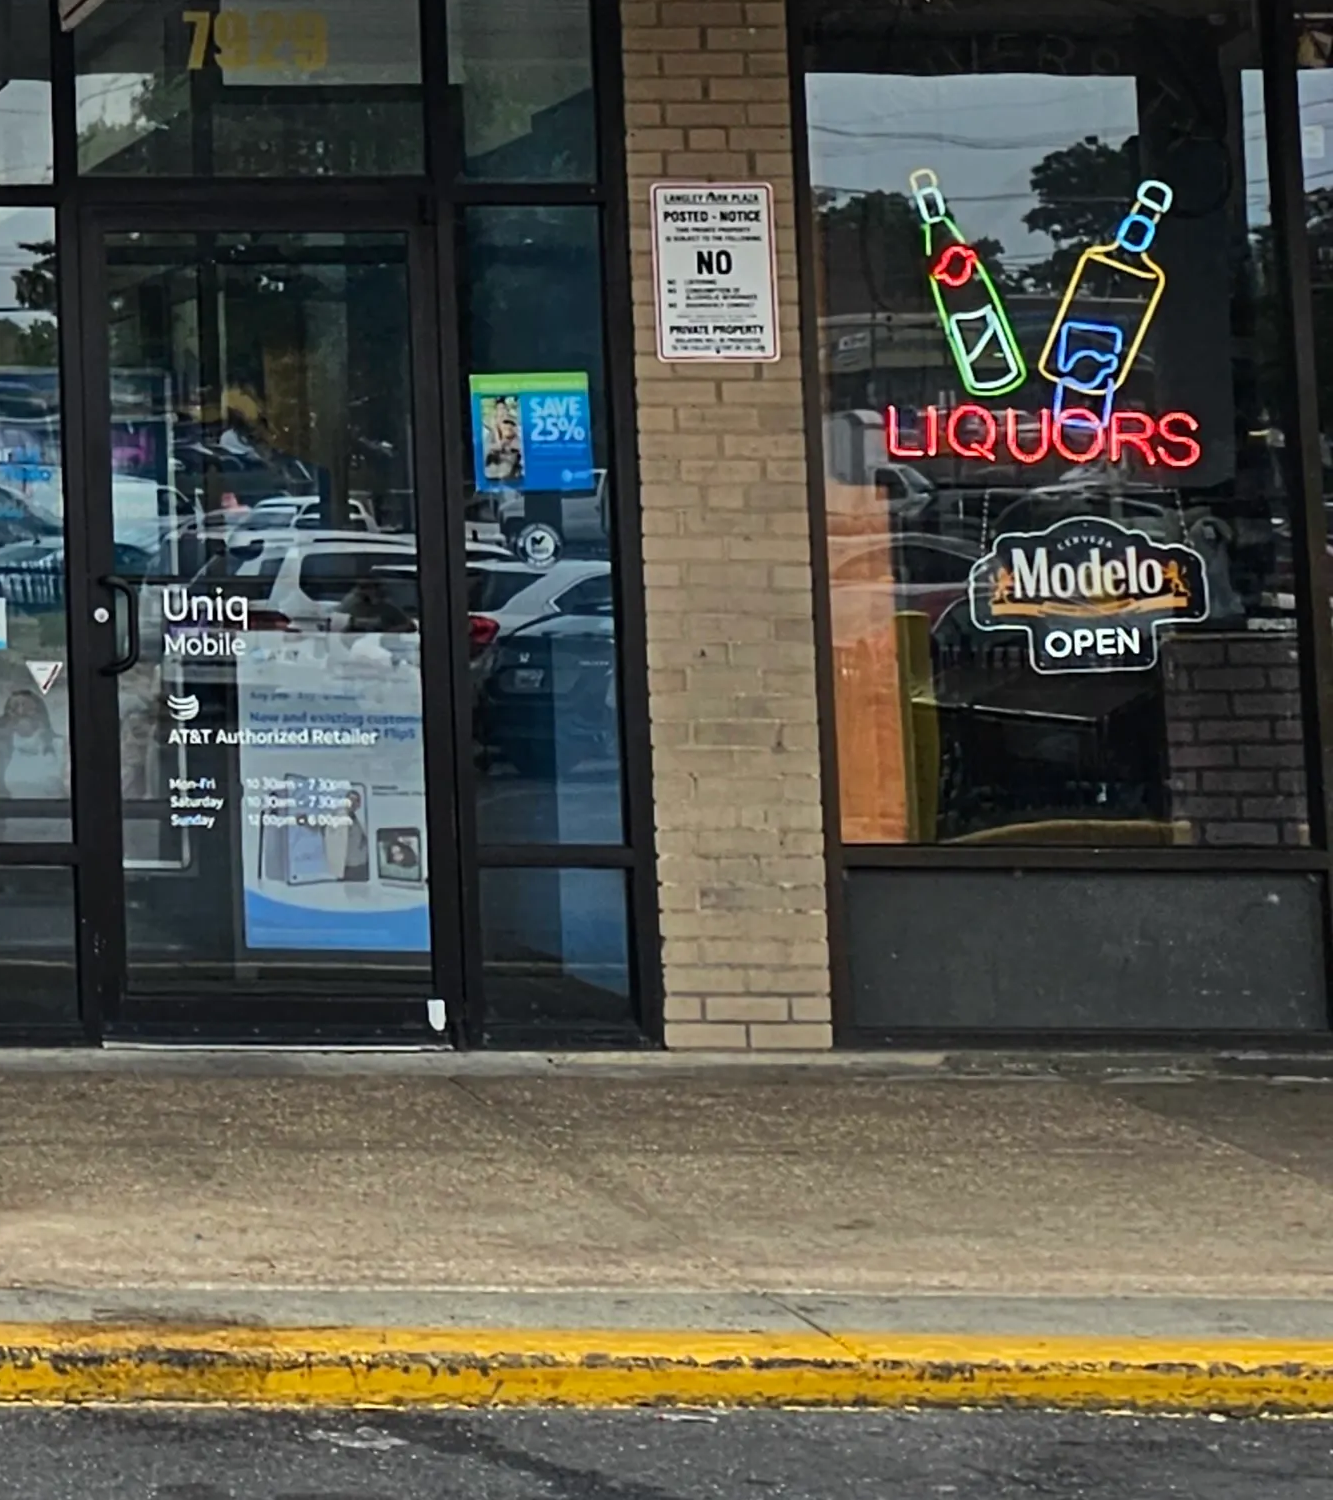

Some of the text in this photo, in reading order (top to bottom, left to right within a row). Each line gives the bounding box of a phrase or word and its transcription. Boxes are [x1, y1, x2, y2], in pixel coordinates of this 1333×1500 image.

[663, 210, 709, 223] POSTED
[719, 210, 761, 223] NOTICE
[696, 249, 733, 276] NO
[528, 396, 583, 418] SAVE
[530, 418, 586, 442] 25%
[884, 404, 1201, 469] LIQUORS
[1057, 535, 1114, 551] CERVEZA
[1010, 545, 1165, 599] Modelo
[162, 587, 248, 631] Uniq
[164, 633, 247, 656] Mobile
[1044, 627, 1141, 659] OPEN
[168, 728, 213, 745] AT&T
[215, 728, 310, 745] Authorized
[312, 728, 379, 746] Retailer
[169, 794, 225, 811] Saturday
[170, 813, 216, 829] Sunday
